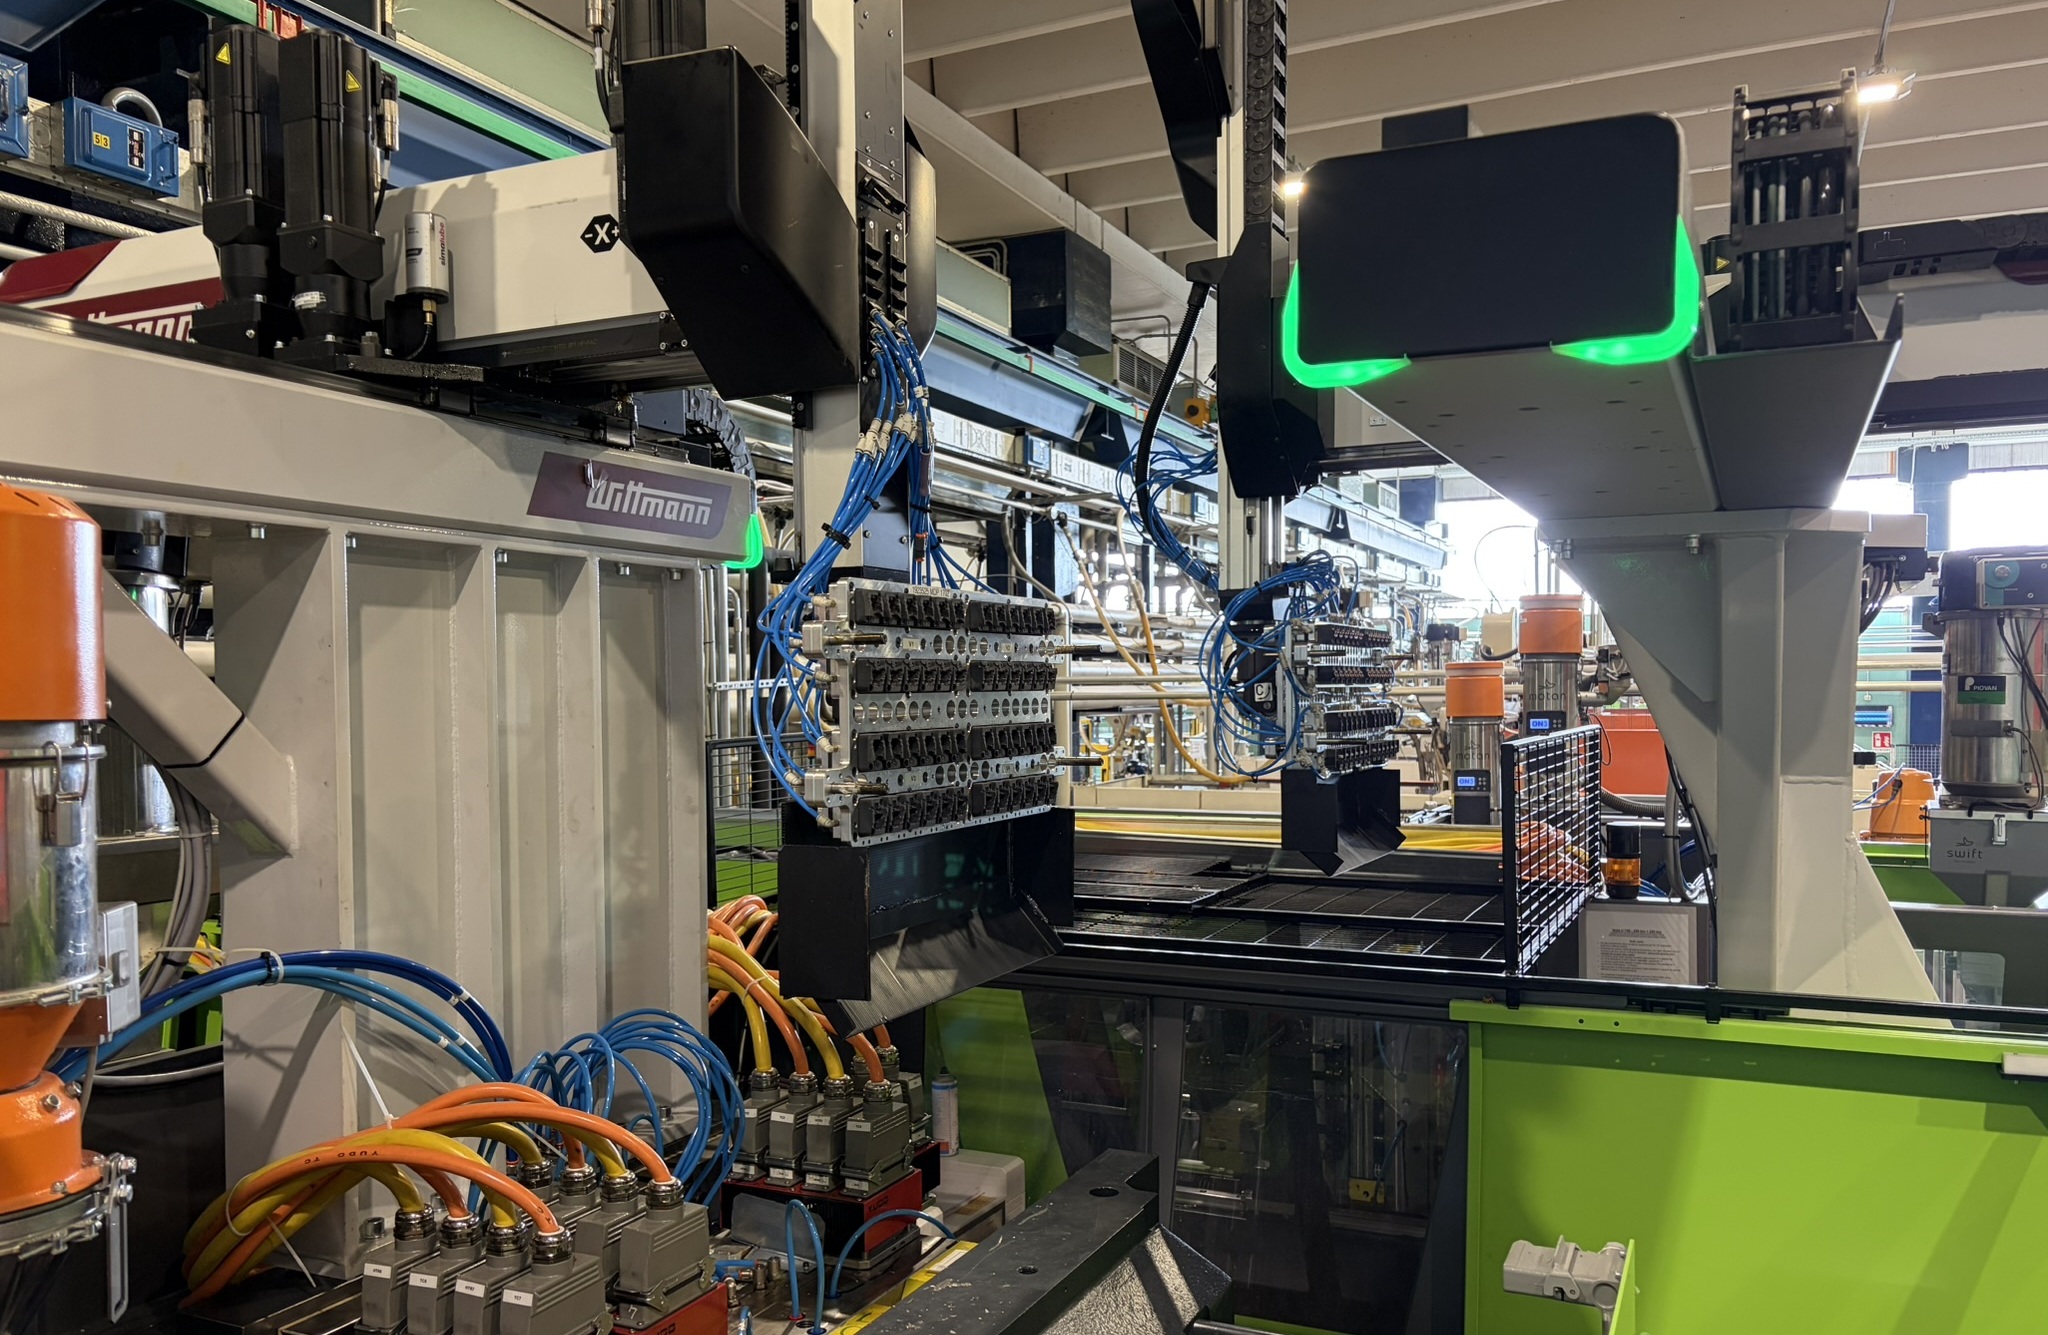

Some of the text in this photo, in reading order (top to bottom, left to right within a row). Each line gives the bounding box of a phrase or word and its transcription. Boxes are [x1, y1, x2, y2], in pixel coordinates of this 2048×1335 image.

[95, 134, 109, 147] 53
[586, 478, 712, 525] Wittmann
[1529, 691, 1567, 700] motan
[1456, 751, 1490, 760] motan
[1947, 848, 1983, 859] swift
[304, 1150, 379, 1165] YUDO TC
